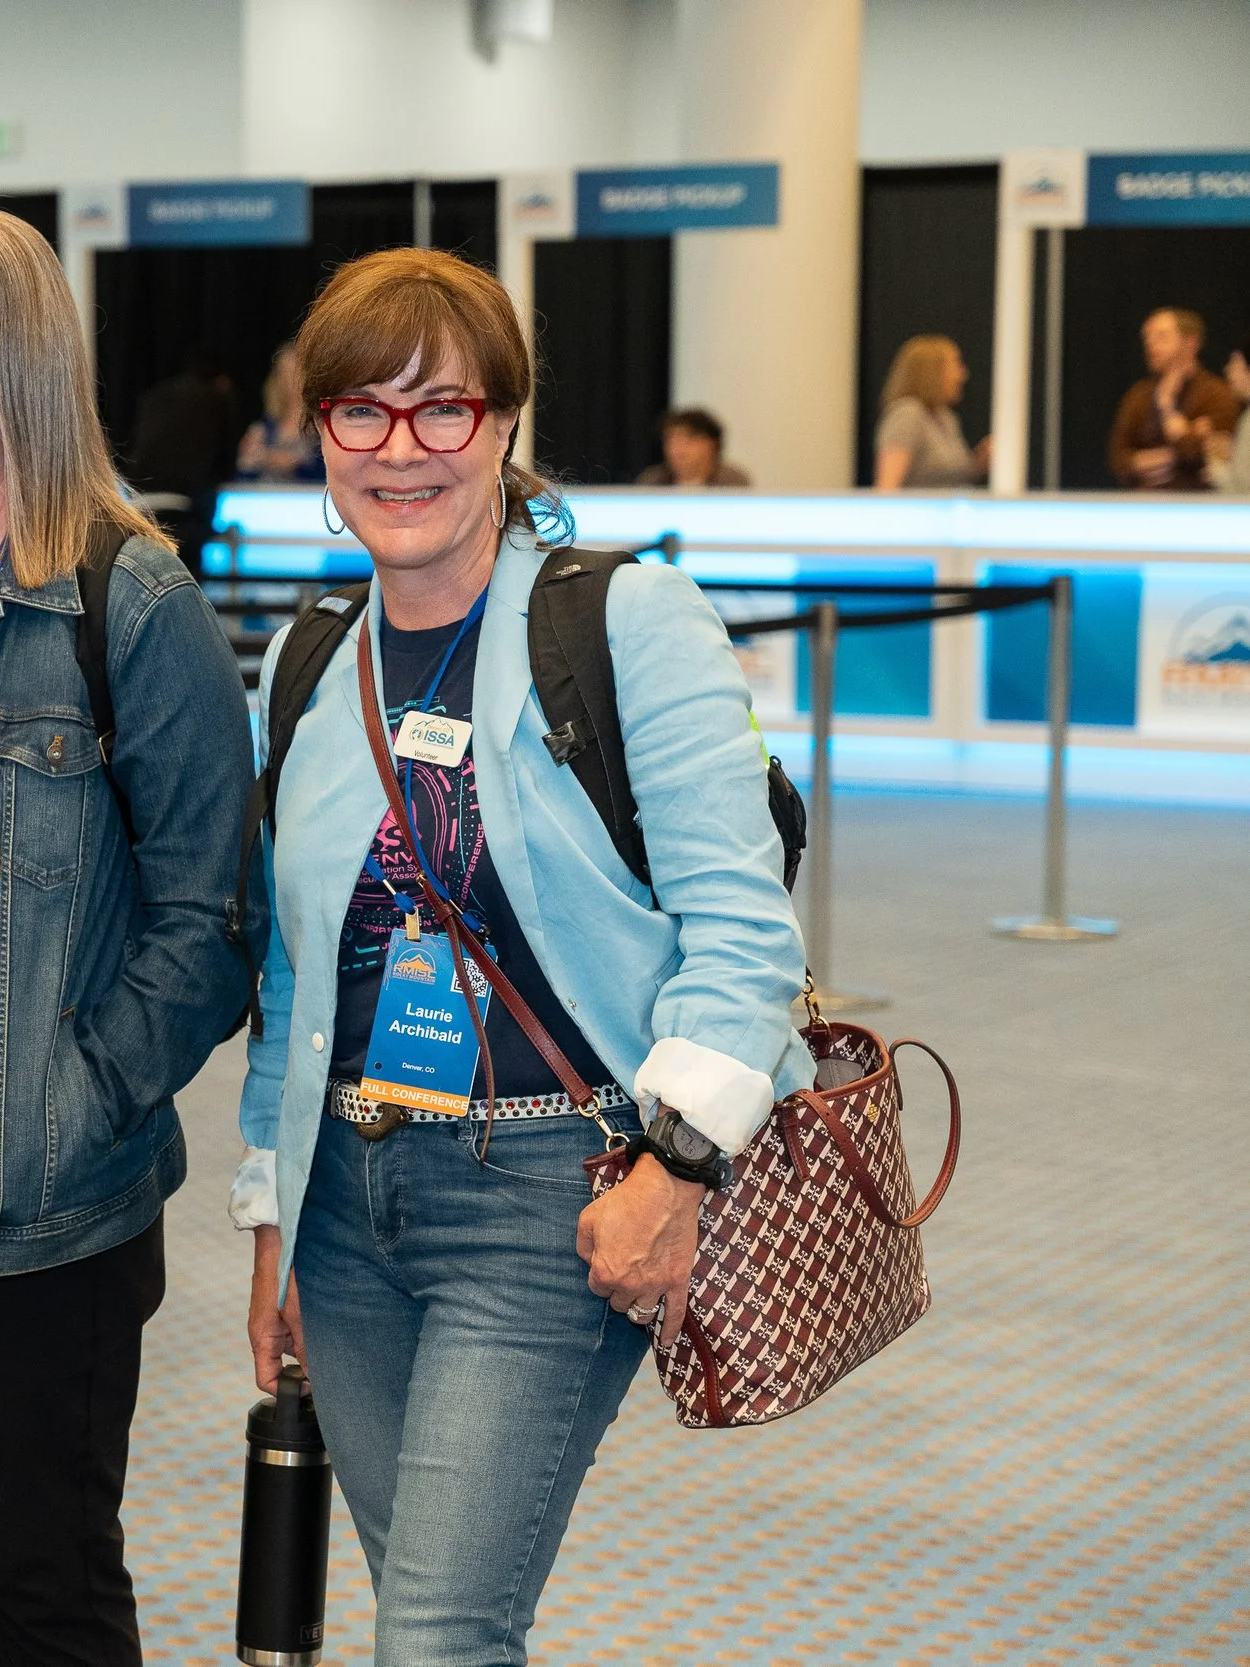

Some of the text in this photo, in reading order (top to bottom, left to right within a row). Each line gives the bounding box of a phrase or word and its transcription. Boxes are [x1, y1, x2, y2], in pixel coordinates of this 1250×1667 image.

[424, 730, 454, 747] ISSA
[414, 750, 438, 761] Volunteer
[406, 1002, 453, 1023] Laurie
[389, 1020, 462, 1045] Archibald
[425, 1066, 435, 1074] CO
[360, 1082, 469, 1111] FULL CONFERENCE
